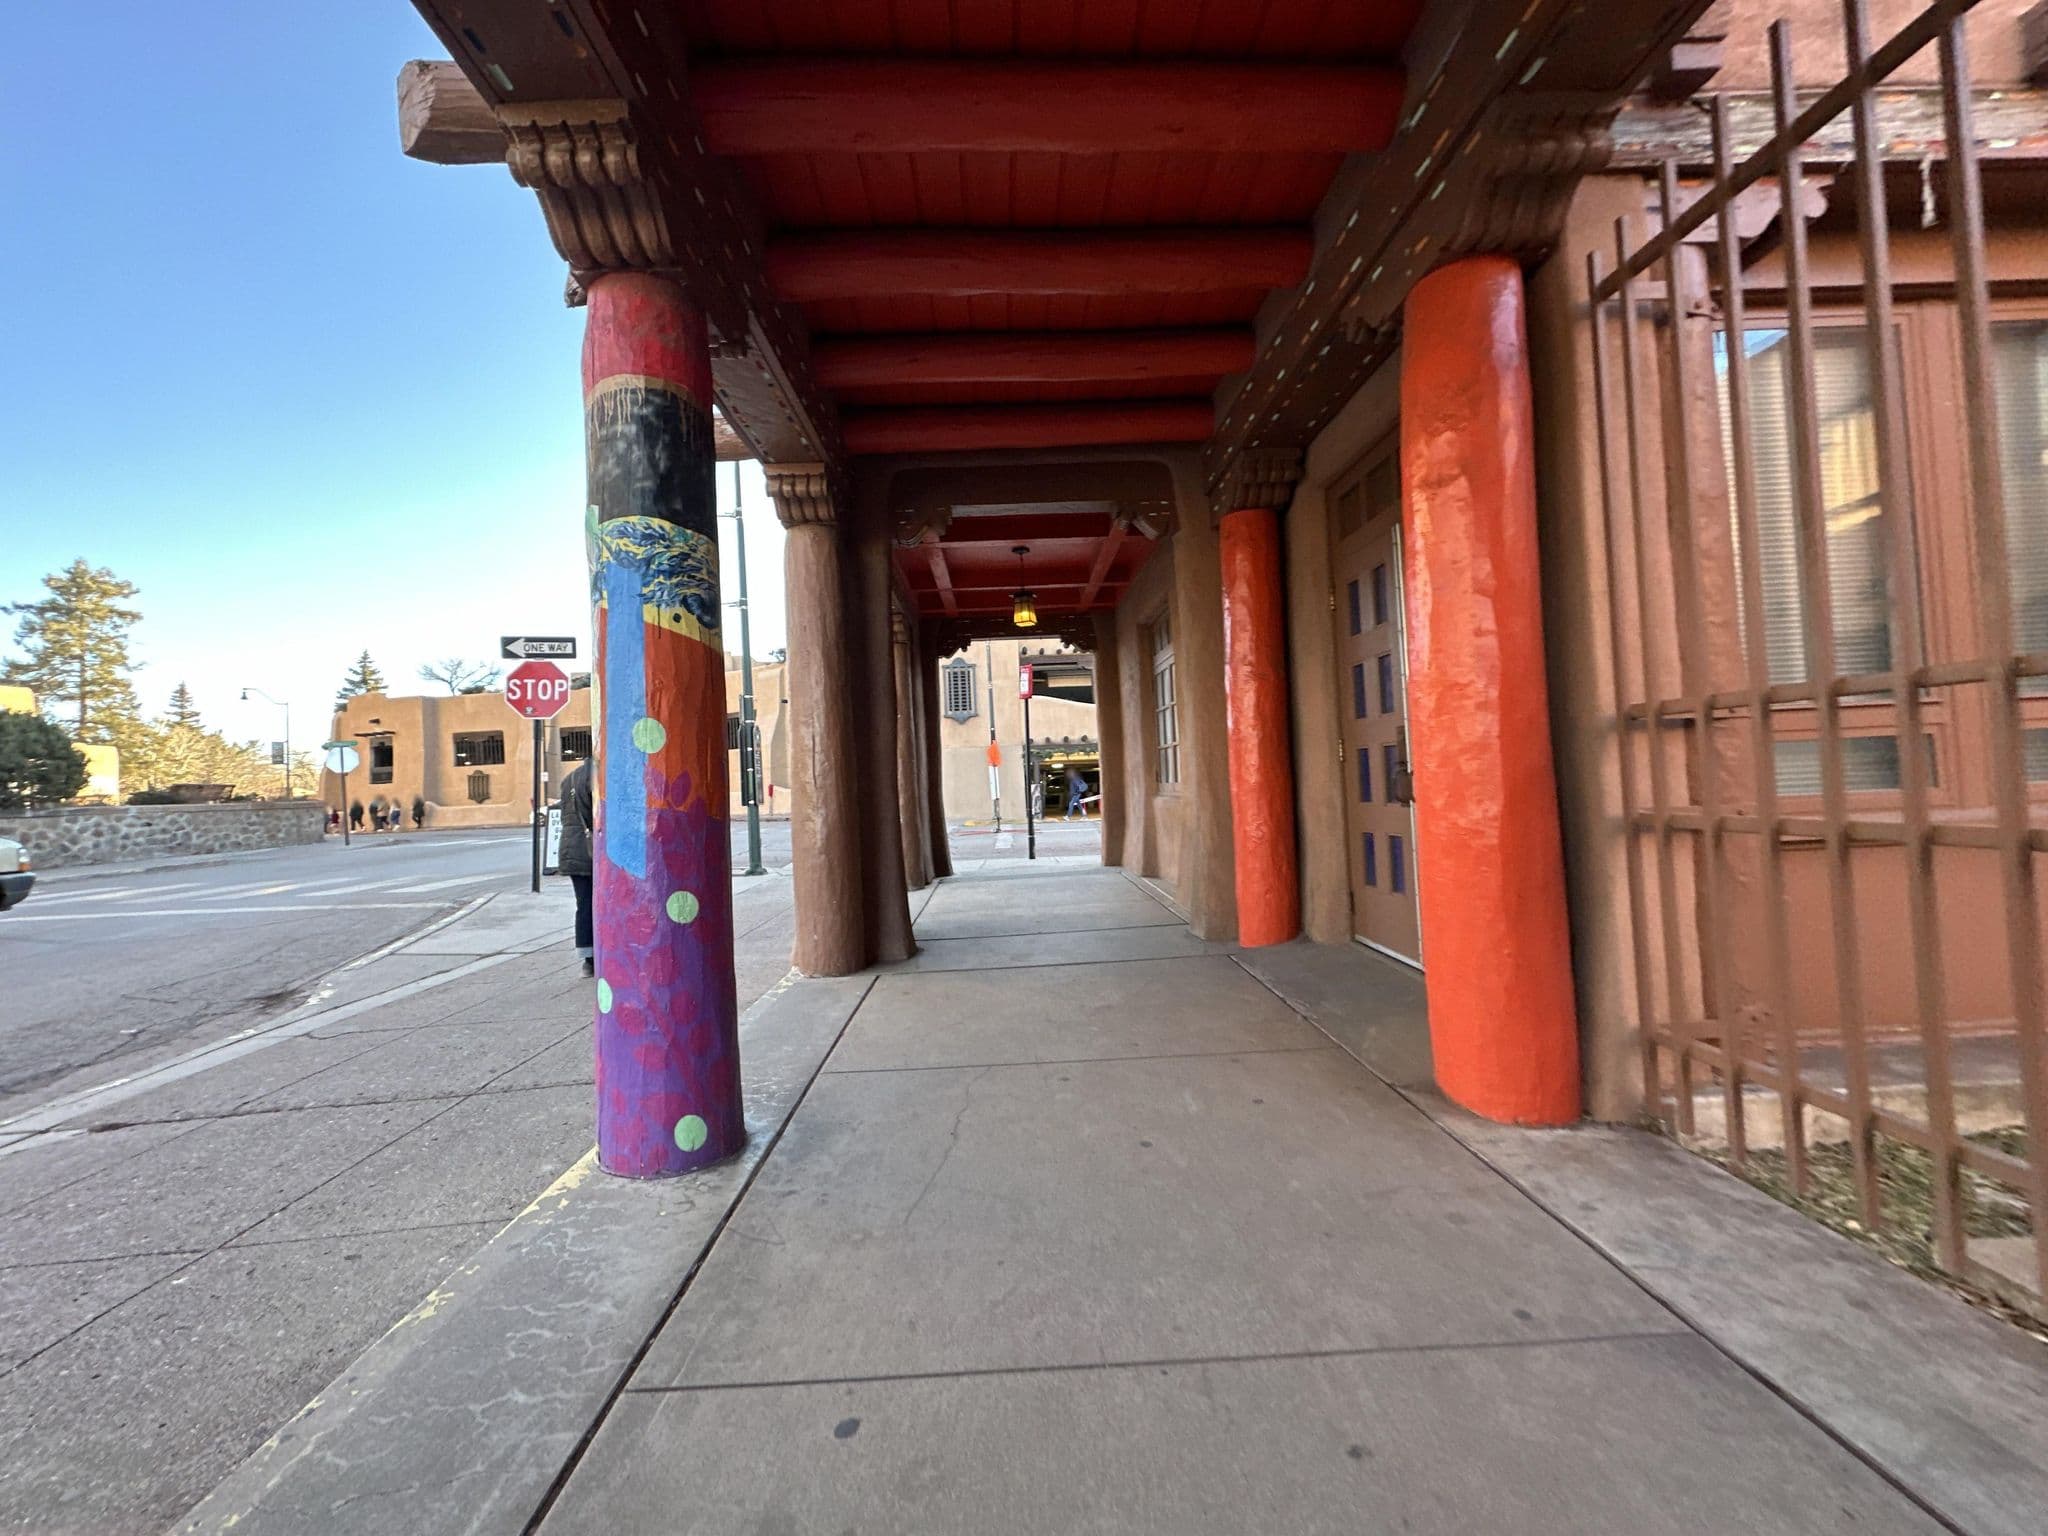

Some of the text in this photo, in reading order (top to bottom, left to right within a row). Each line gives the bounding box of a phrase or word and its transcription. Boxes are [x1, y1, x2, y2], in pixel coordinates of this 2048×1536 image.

[524, 643, 568, 652] ONE WAY
[508, 678, 567, 701] STOP
